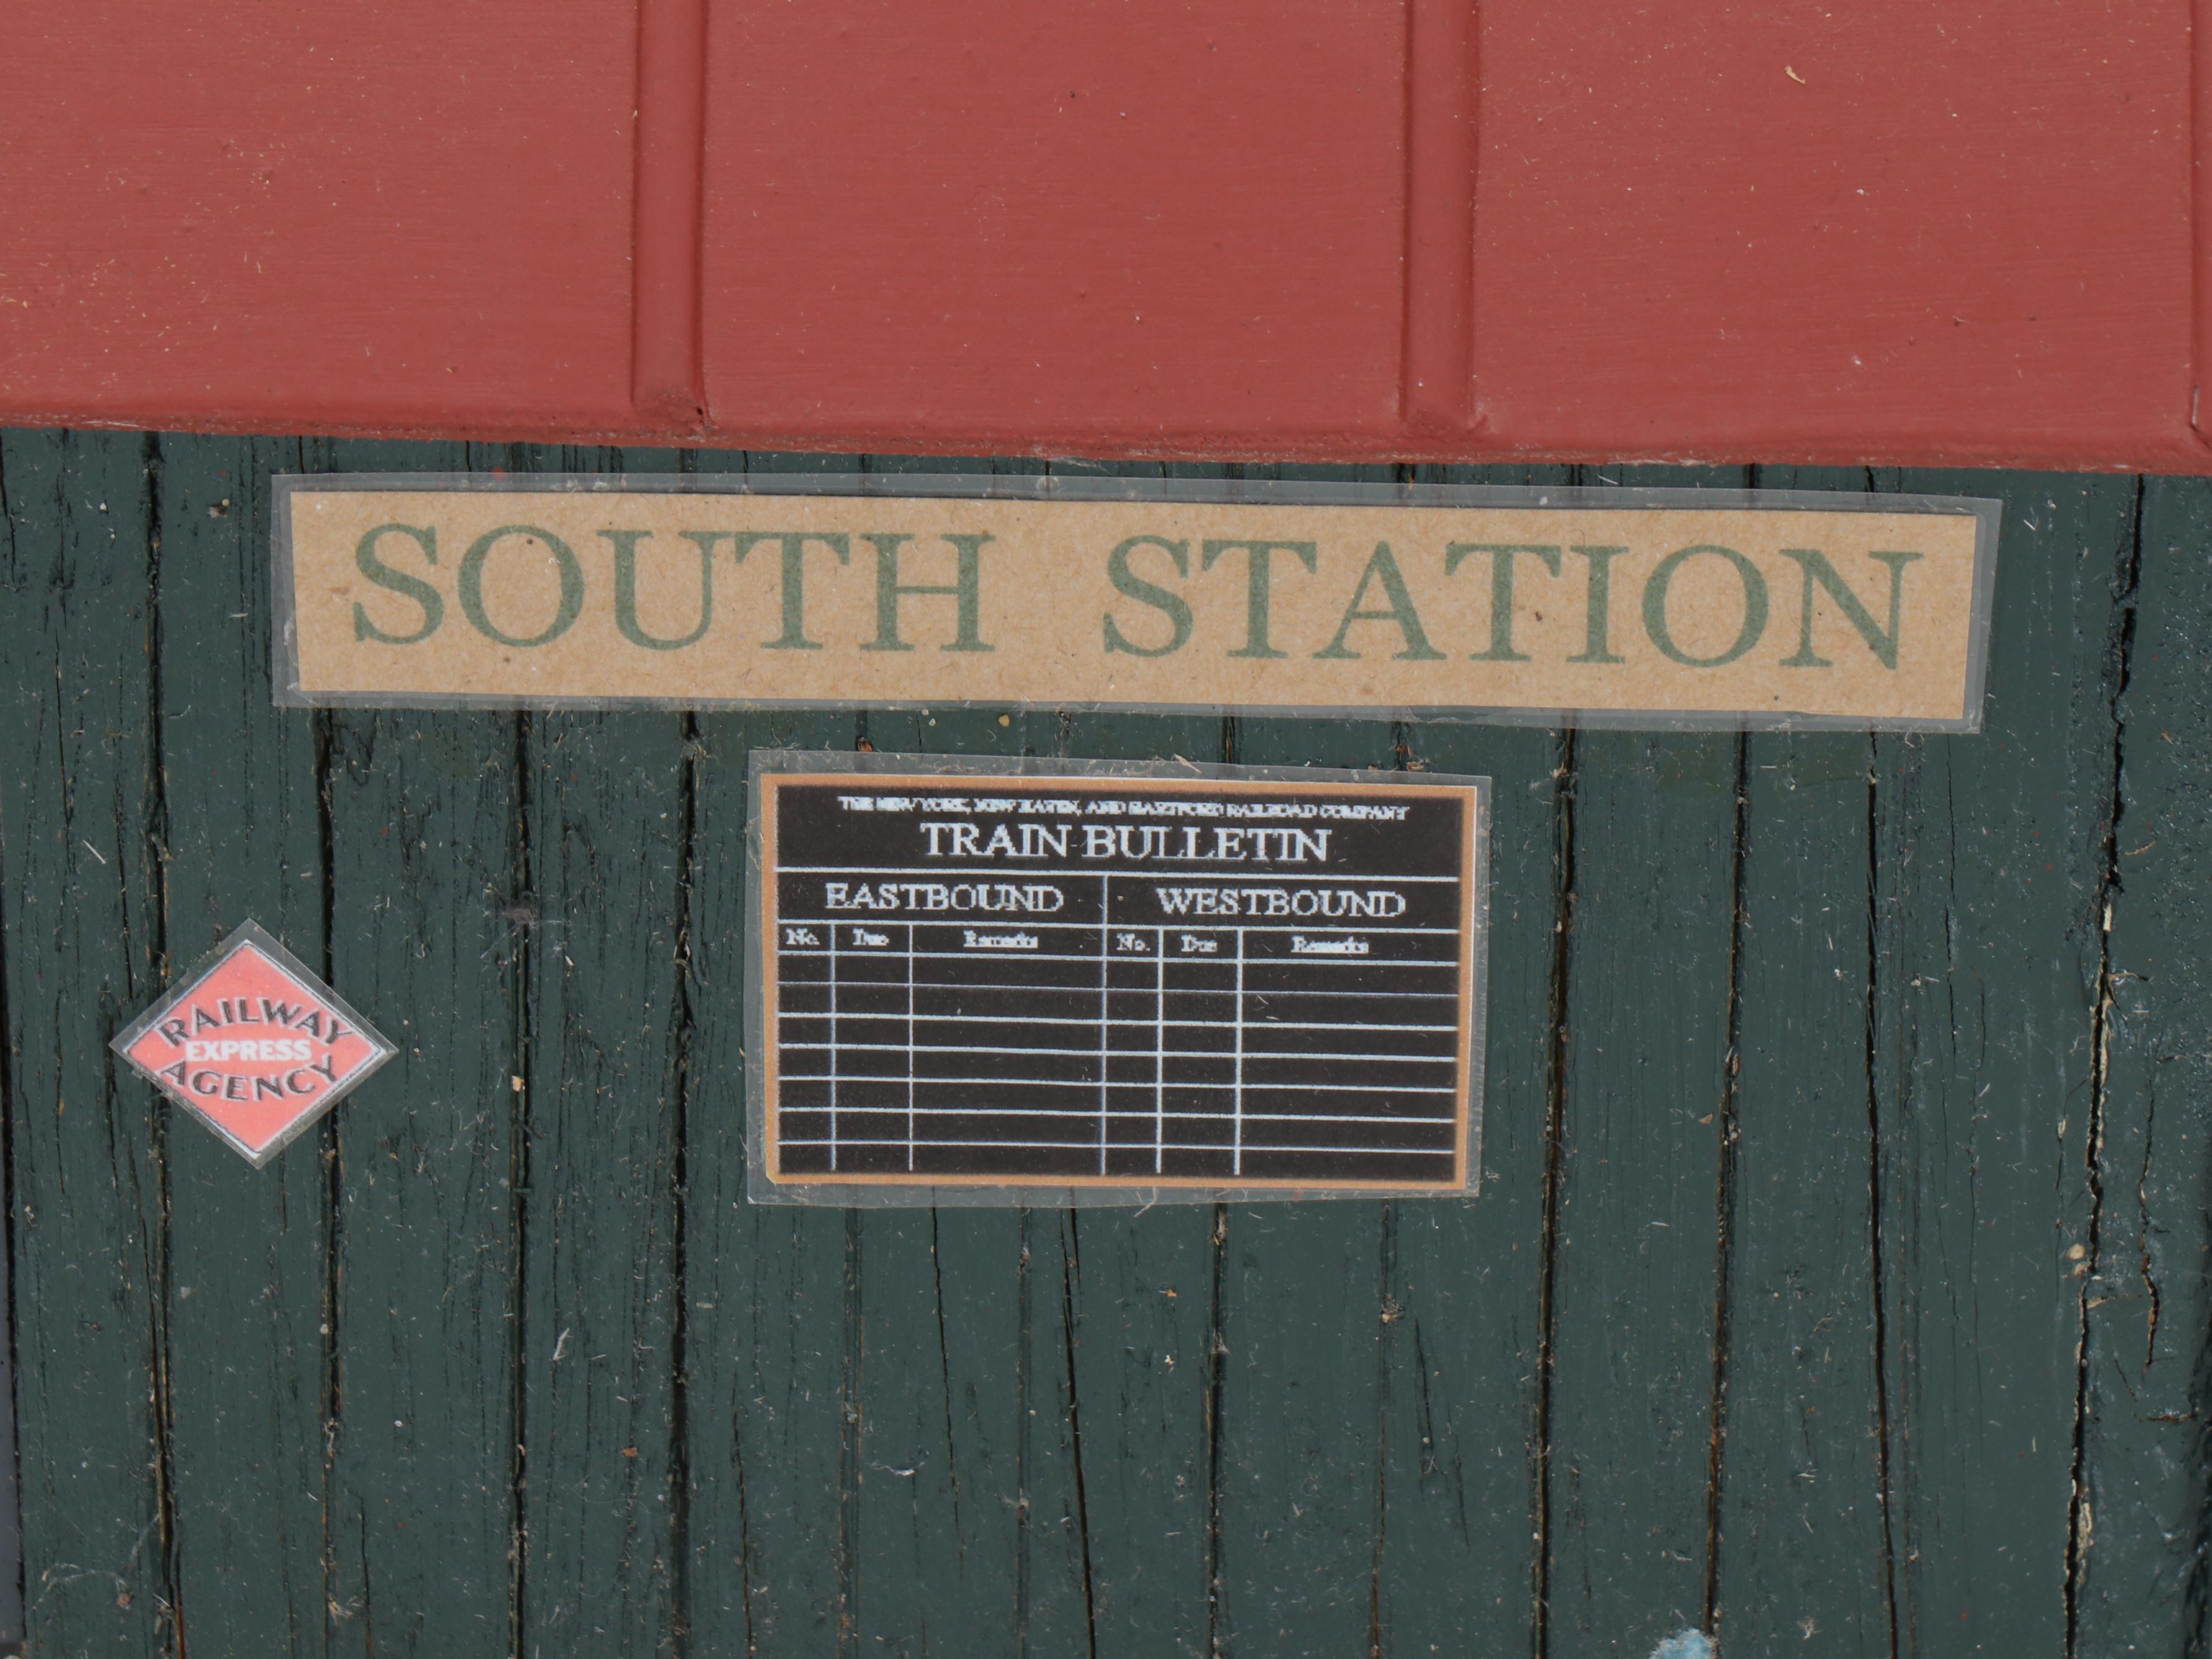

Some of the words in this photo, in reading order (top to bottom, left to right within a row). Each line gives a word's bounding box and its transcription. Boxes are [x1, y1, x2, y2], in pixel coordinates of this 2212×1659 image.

[353, 523, 996, 651] SOUTH
[1102, 534, 1924, 671] STATION
[920, 822, 1071, 858] TRAIN
[1082, 826, 1333, 861] BULLETIN
[825, 882, 1064, 912] EASTBOUND
[1156, 887, 1407, 918] WESTBOUND
[786, 928, 820, 945] No.
[1117, 933, 1151, 952] No.
[1181, 935, 1217, 953] Due
[154, 997, 352, 1047] RAILWAY
[186, 1039, 311, 1062] EXPRESS
[155, 1054, 338, 1101] AGENCY
